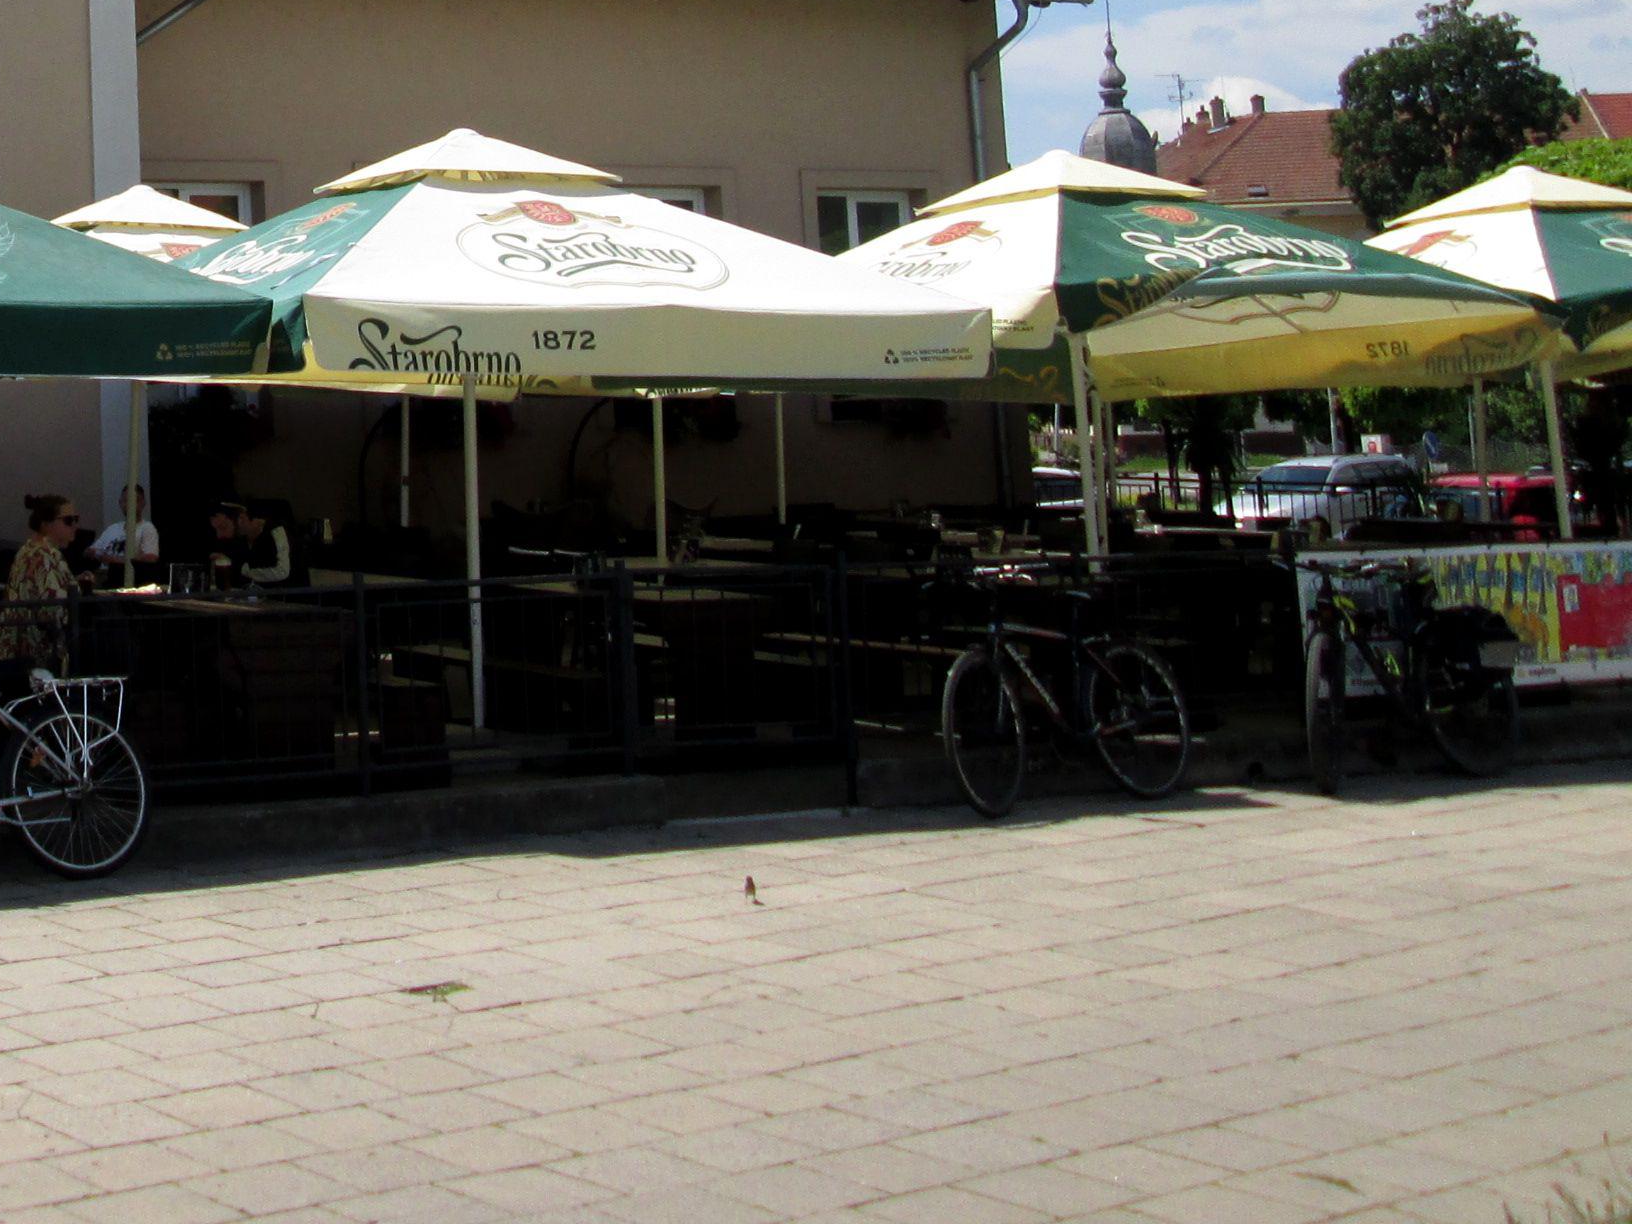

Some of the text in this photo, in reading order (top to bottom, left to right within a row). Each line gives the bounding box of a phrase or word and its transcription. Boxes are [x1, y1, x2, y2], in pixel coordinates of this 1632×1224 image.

[491, 231, 697, 277] Starobrno
[1120, 223, 1352, 274] Starobrno
[348, 317, 597, 374] Starobrno 1872
